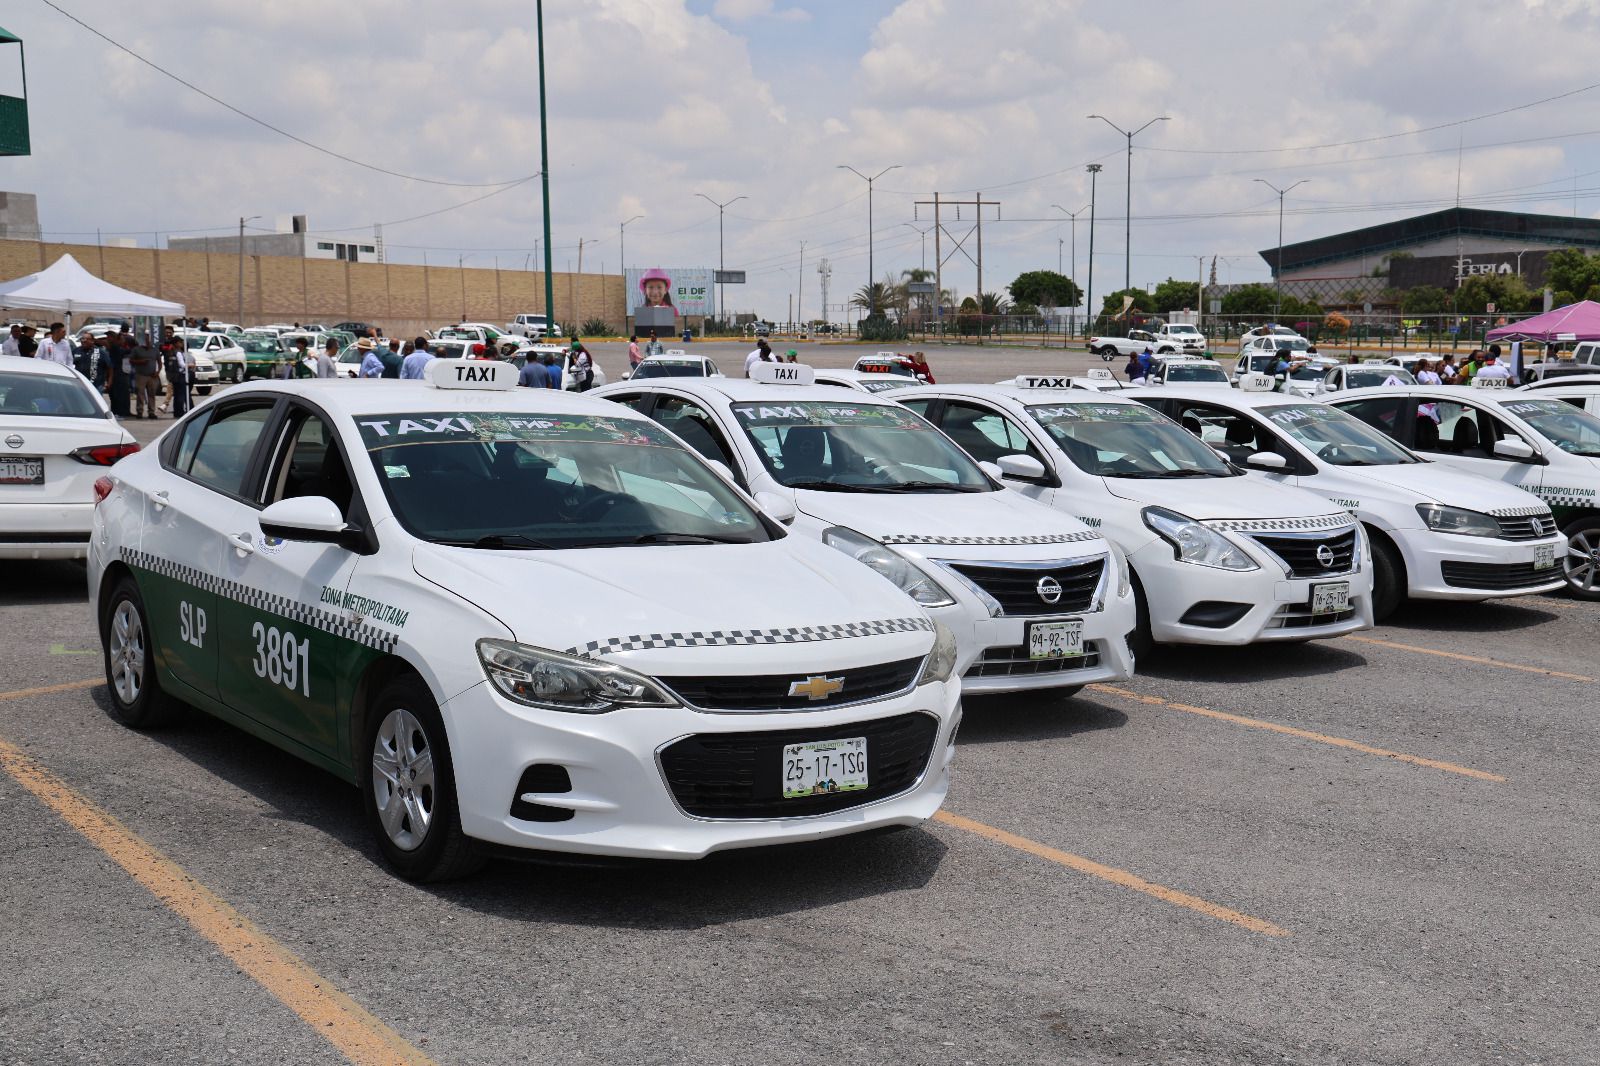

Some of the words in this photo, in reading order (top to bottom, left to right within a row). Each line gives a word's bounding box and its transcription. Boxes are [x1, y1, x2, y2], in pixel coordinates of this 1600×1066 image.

[455, 366, 496, 382] TAXI
[774, 369, 798, 380] TAXI
[864, 382, 895, 390] TAXI
[1026, 378, 1071, 387] TAXI
[1255, 378, 1270, 387] TAXI
[1480, 379, 1506, 387] TAXI
[735, 406, 807, 420] TAXI
[1506, 403, 1542, 414] TAXI
[1270, 409, 1308, 424] TAXI
[360, 417, 472, 437] TAXI
[1531, 485, 1596, 496] METROPOLITANA
[320, 586, 342, 607] ZONA
[342, 592, 409, 628] METROPOLITANA
[180, 600, 207, 649] SLP
[1032, 631, 1082, 647] 94-92-TSF
[252, 621, 310, 698] 3891
[786, 752, 865, 781] 25-17-TSG
